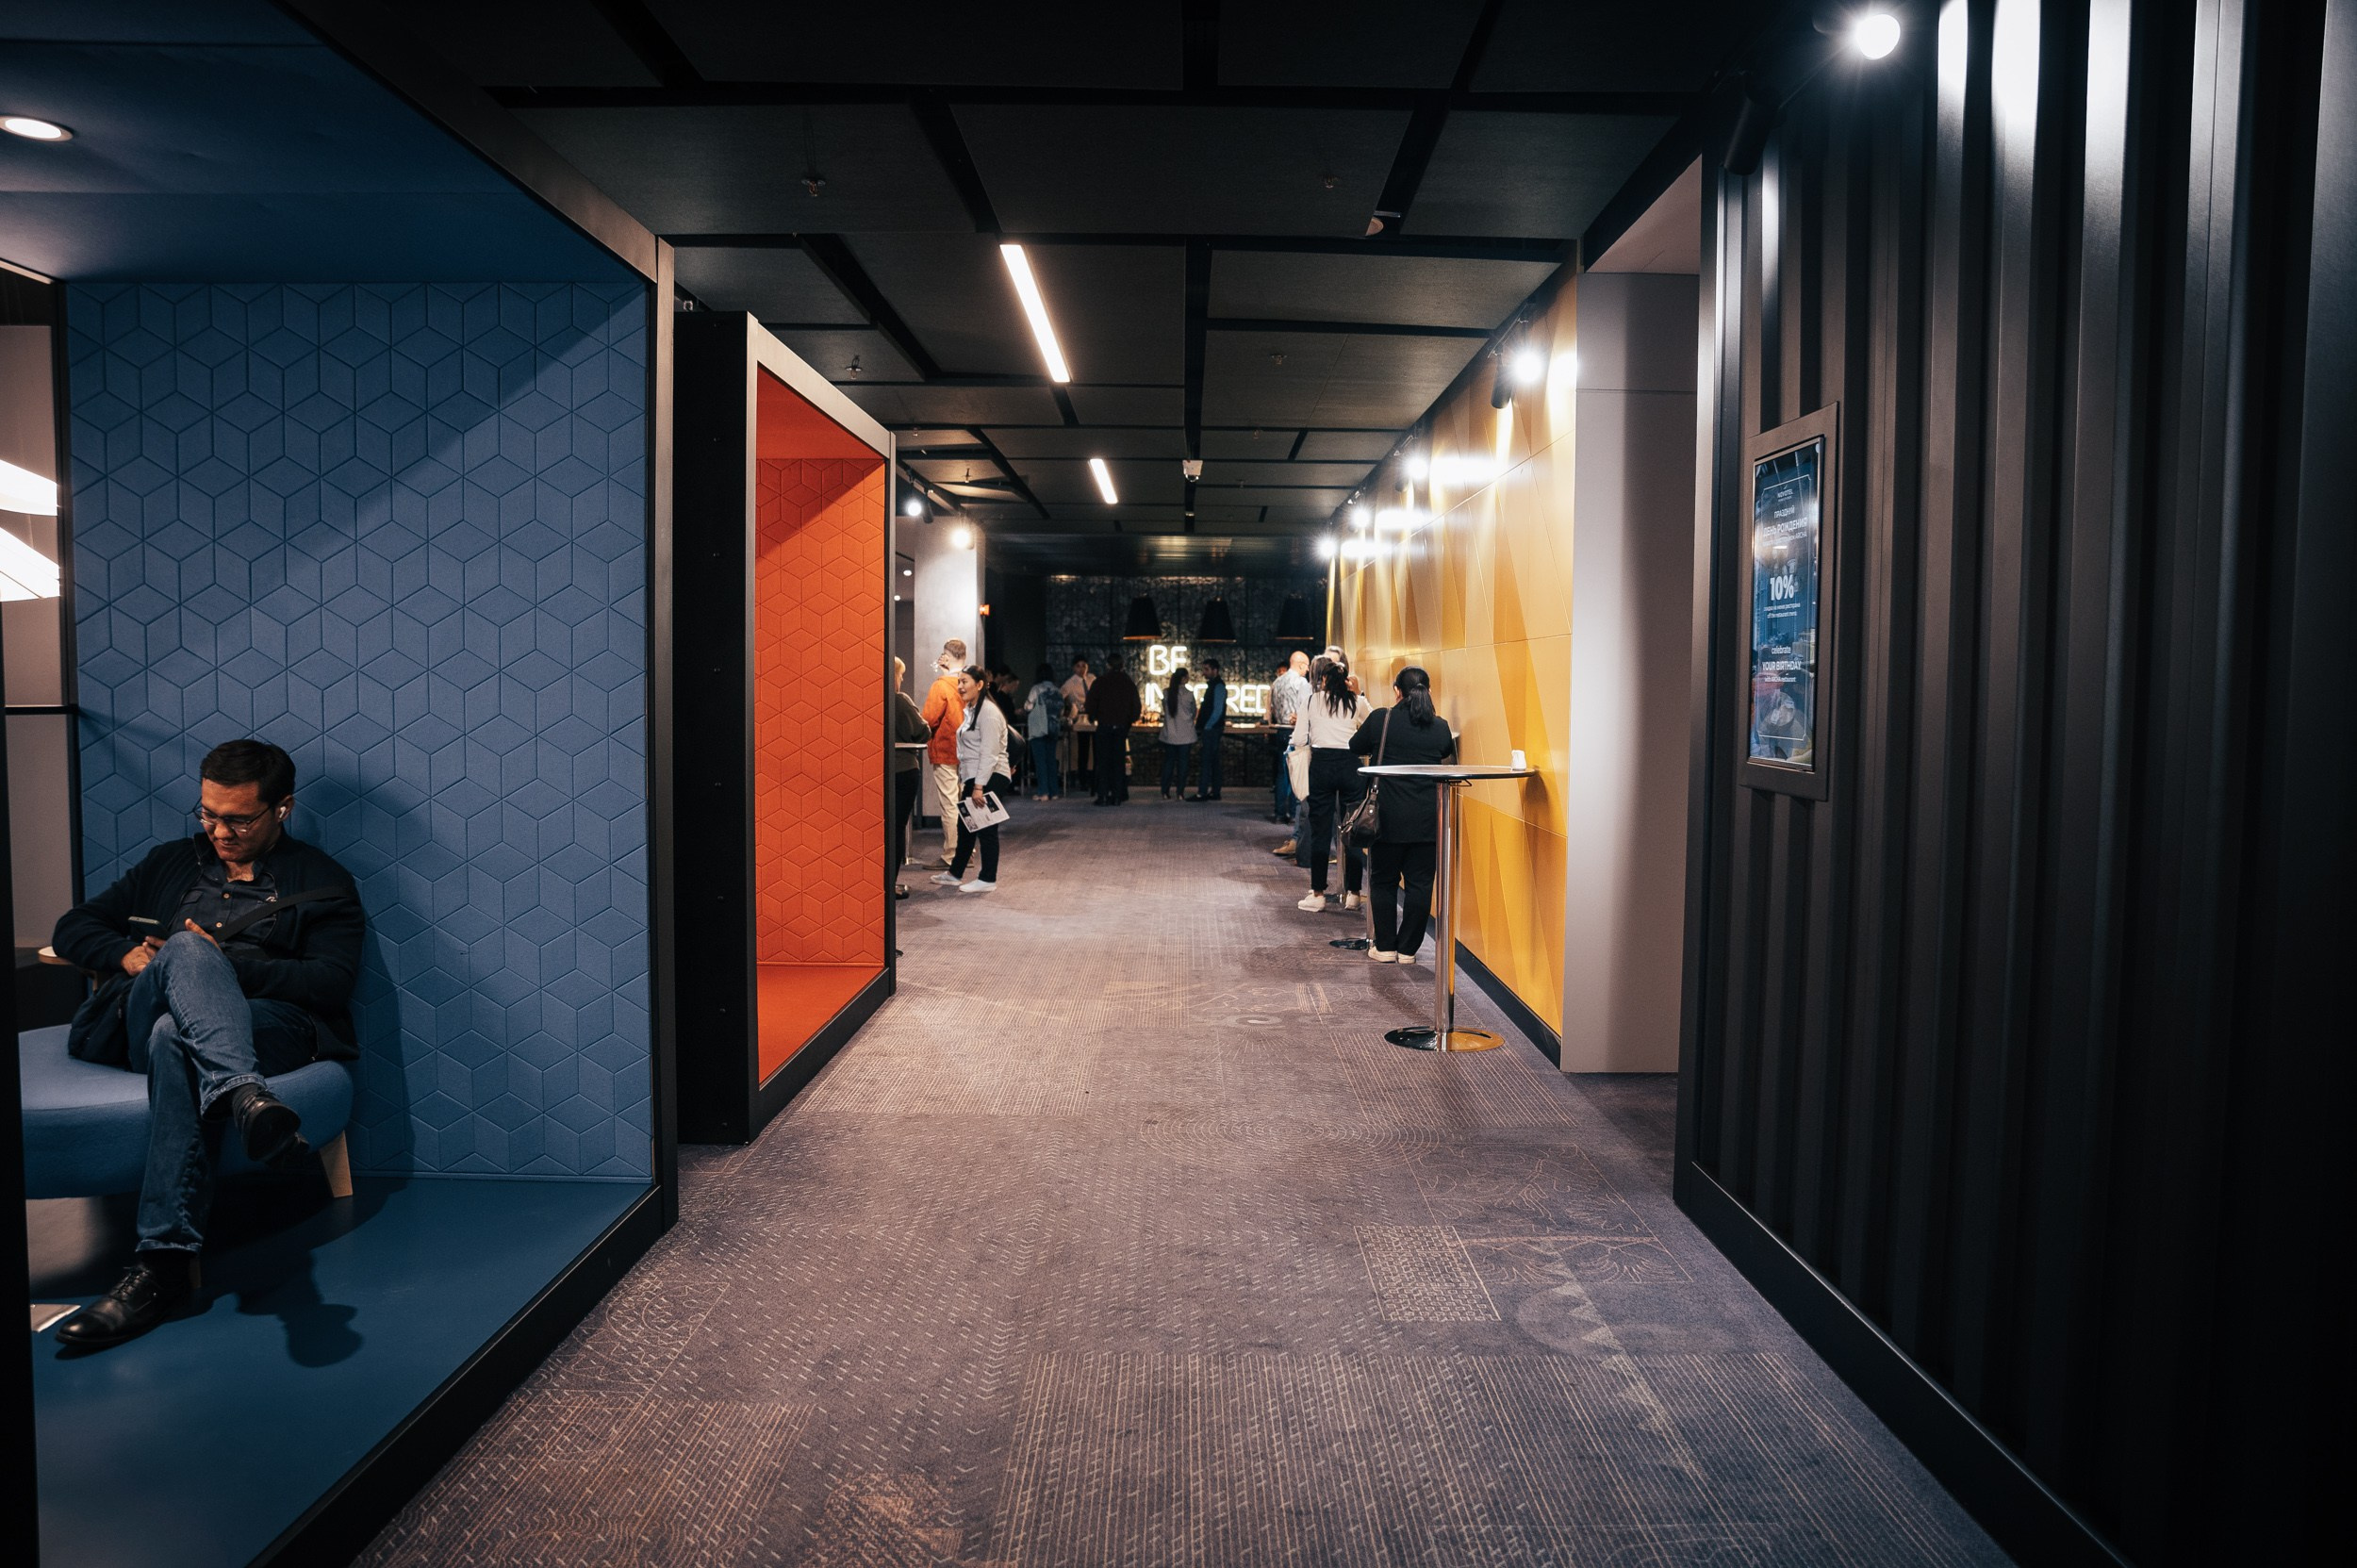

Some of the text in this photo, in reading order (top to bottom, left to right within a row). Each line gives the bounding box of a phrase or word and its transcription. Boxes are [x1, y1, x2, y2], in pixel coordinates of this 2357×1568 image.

[1763, 517, 1807, 536] ДЕНЬ РОЖДЕНИЯ
[1770, 574, 1794, 601] 10%
[1149, 645, 1188, 676] BE
[1772, 646, 1791, 654] celebrate
[1762, 660, 1801, 670] YOUR BIRTHDAY
[1145, 683, 1271, 714] INRED
